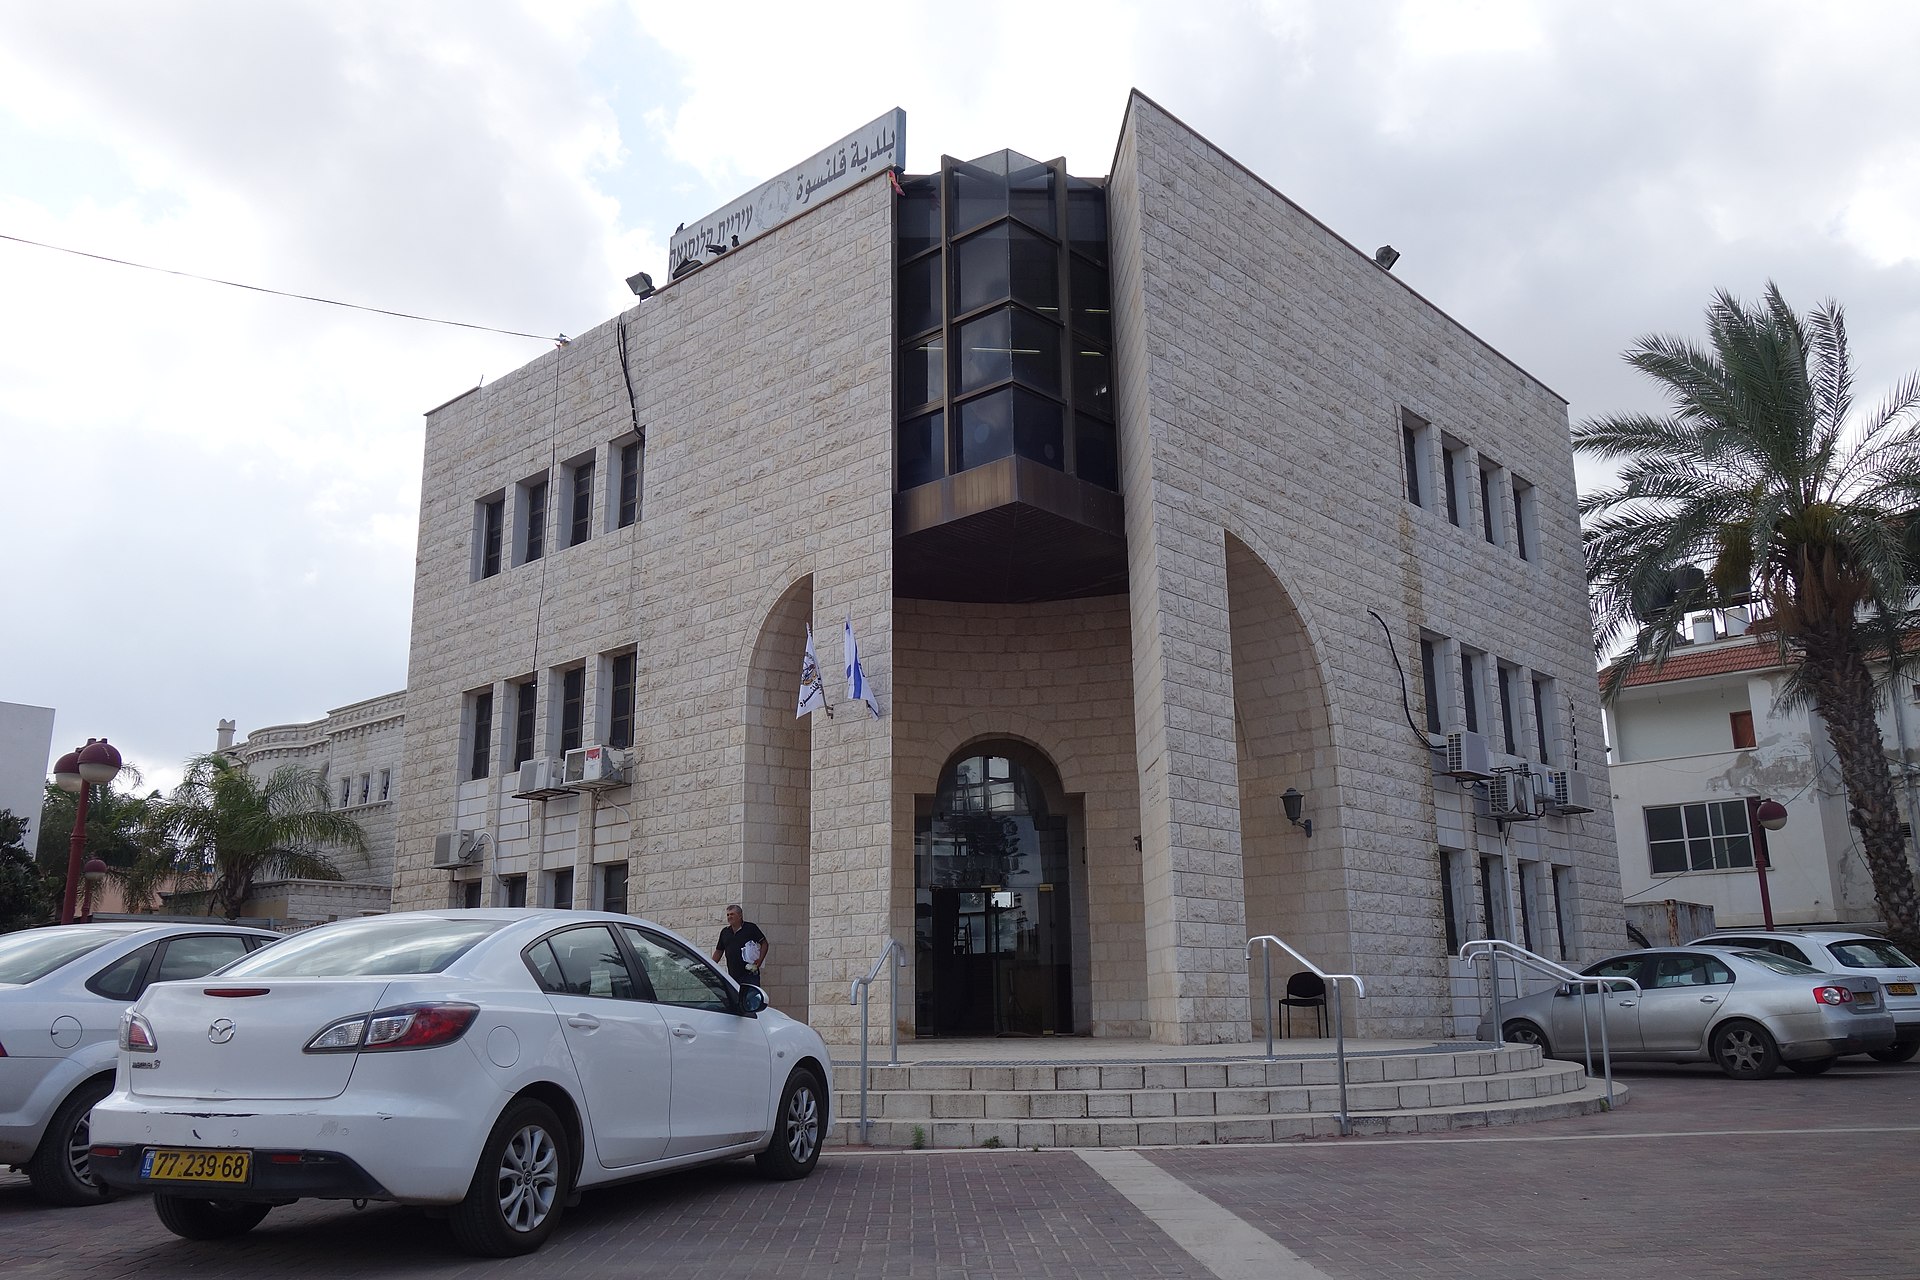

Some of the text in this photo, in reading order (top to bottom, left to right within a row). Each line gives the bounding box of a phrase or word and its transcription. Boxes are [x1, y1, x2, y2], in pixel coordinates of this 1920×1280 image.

[850, 125, 895, 173] بلدية
[796, 147, 847, 204] قلنسوة
[717, 204, 753, 244] עיריית
